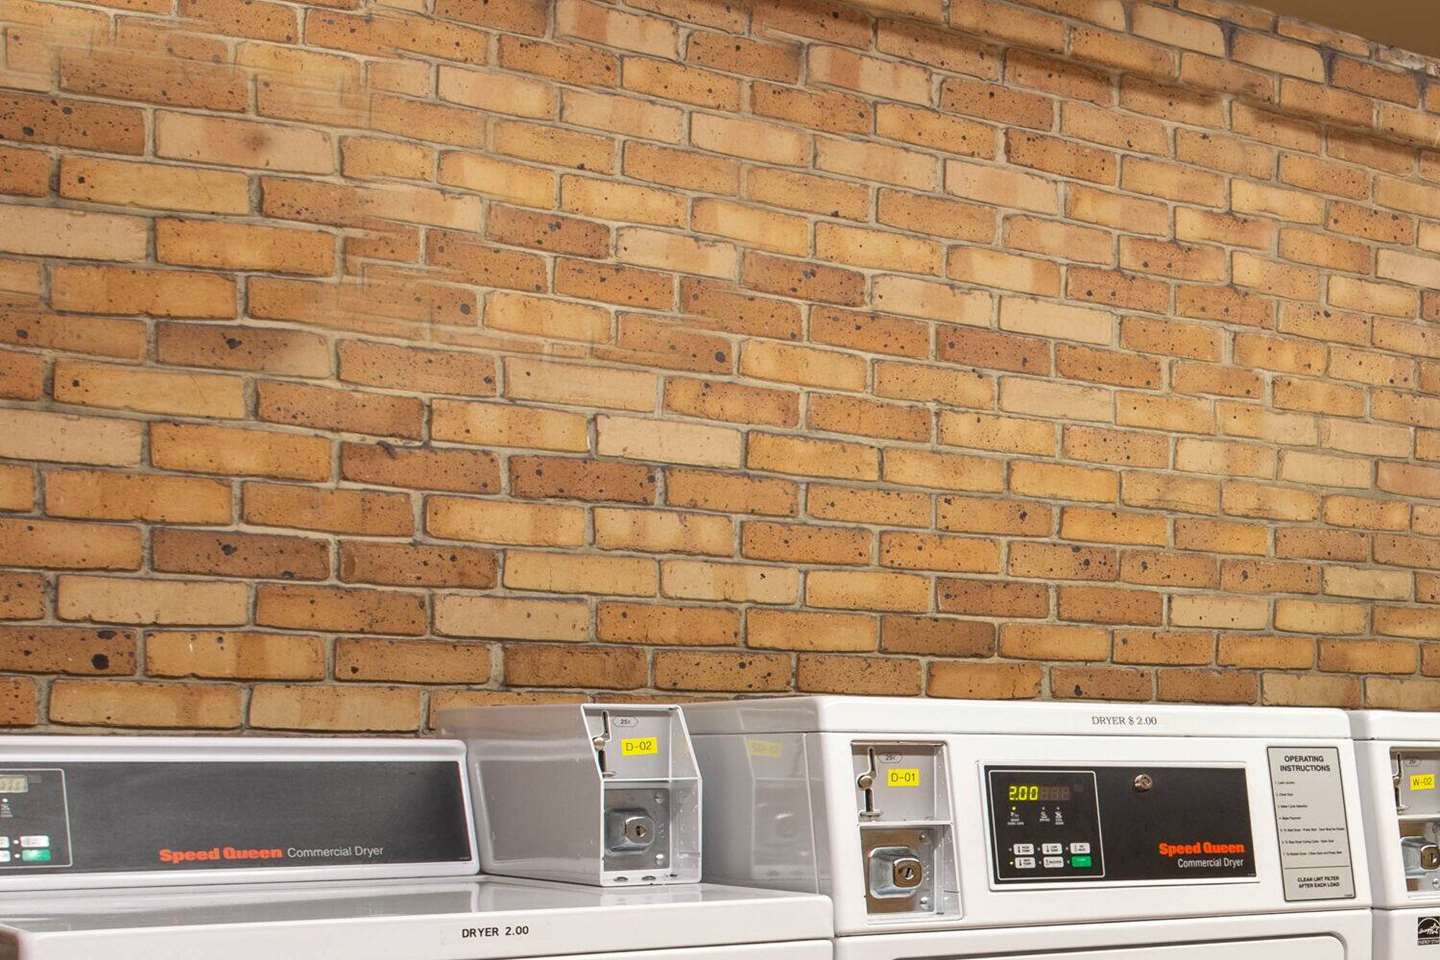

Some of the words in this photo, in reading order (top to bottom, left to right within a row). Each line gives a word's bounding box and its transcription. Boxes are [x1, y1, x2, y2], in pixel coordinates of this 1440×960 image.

[1091, 716, 1126, 726] DRYER
[1128, 716, 1134, 726] $
[1137, 716, 1158, 726] 2.00
[625, 741, 652, 752] D-02
[1284, 755, 1324, 763] OPERATING
[891, 772, 915, 783] D-01
[1412, 776, 1433, 786] W-02
[1009, 786, 1039, 801] 2.00
[159, 847, 220, 864] Speed
[223, 845, 284, 860] Queen
[287, 847, 352, 858] Commercial
[354, 845, 384, 858] Dryer
[1159, 841, 1201, 857] Speed
[1203, 841, 1245, 854] Queen
[1178, 857, 1222, 868] Commercial
[1224, 857, 1244, 869] Dryer
[461, 927, 500, 938] DRYER
[505, 925, 529, 936] 2.00
